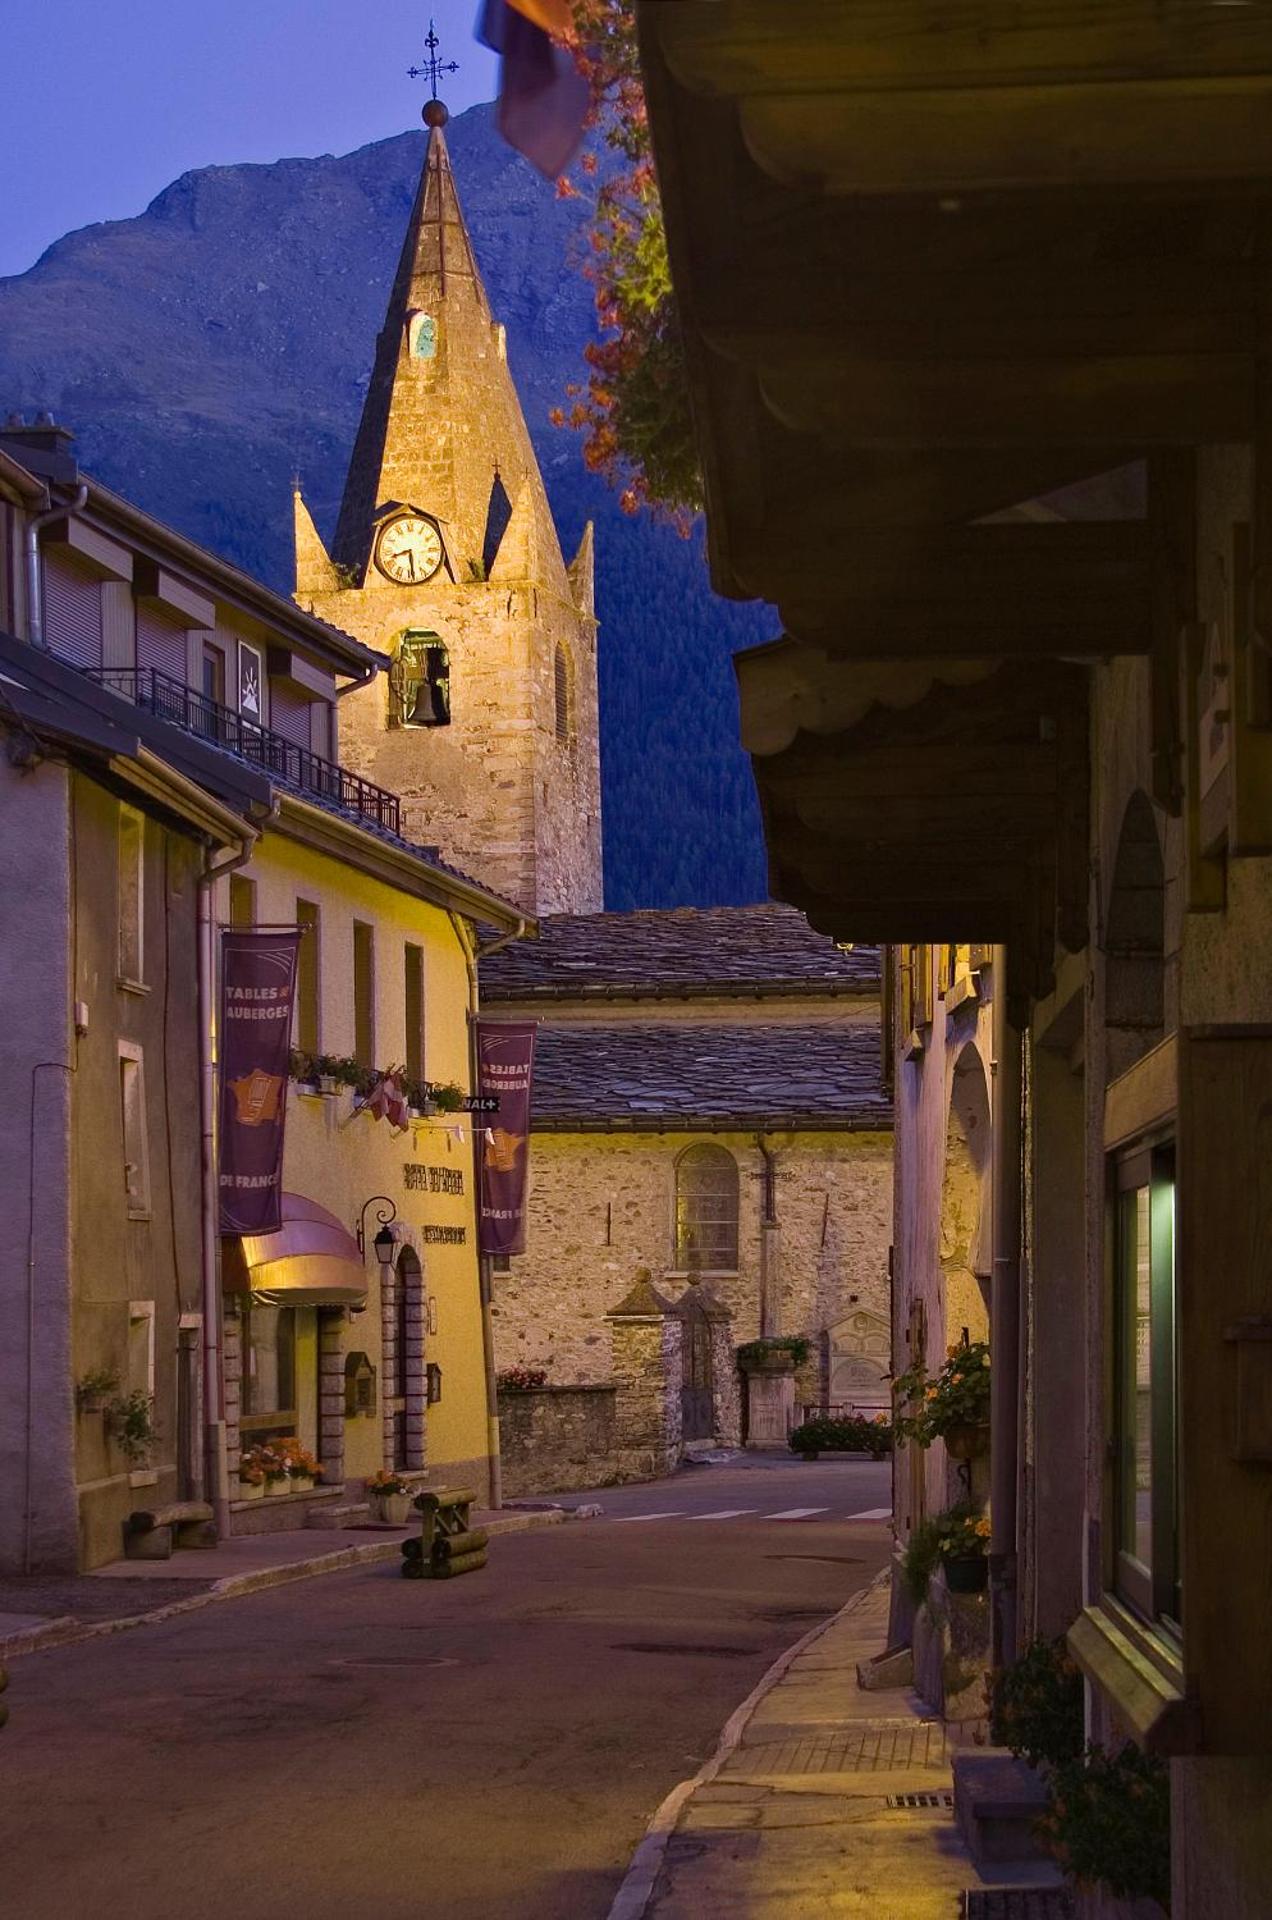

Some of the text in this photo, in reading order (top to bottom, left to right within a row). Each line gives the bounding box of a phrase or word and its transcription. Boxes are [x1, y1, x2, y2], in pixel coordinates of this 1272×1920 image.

[225, 986, 278, 999] TABLES
[227, 1005, 289, 1019] AUBERGES
[219, 1174, 278, 1188] DE FRANCE
